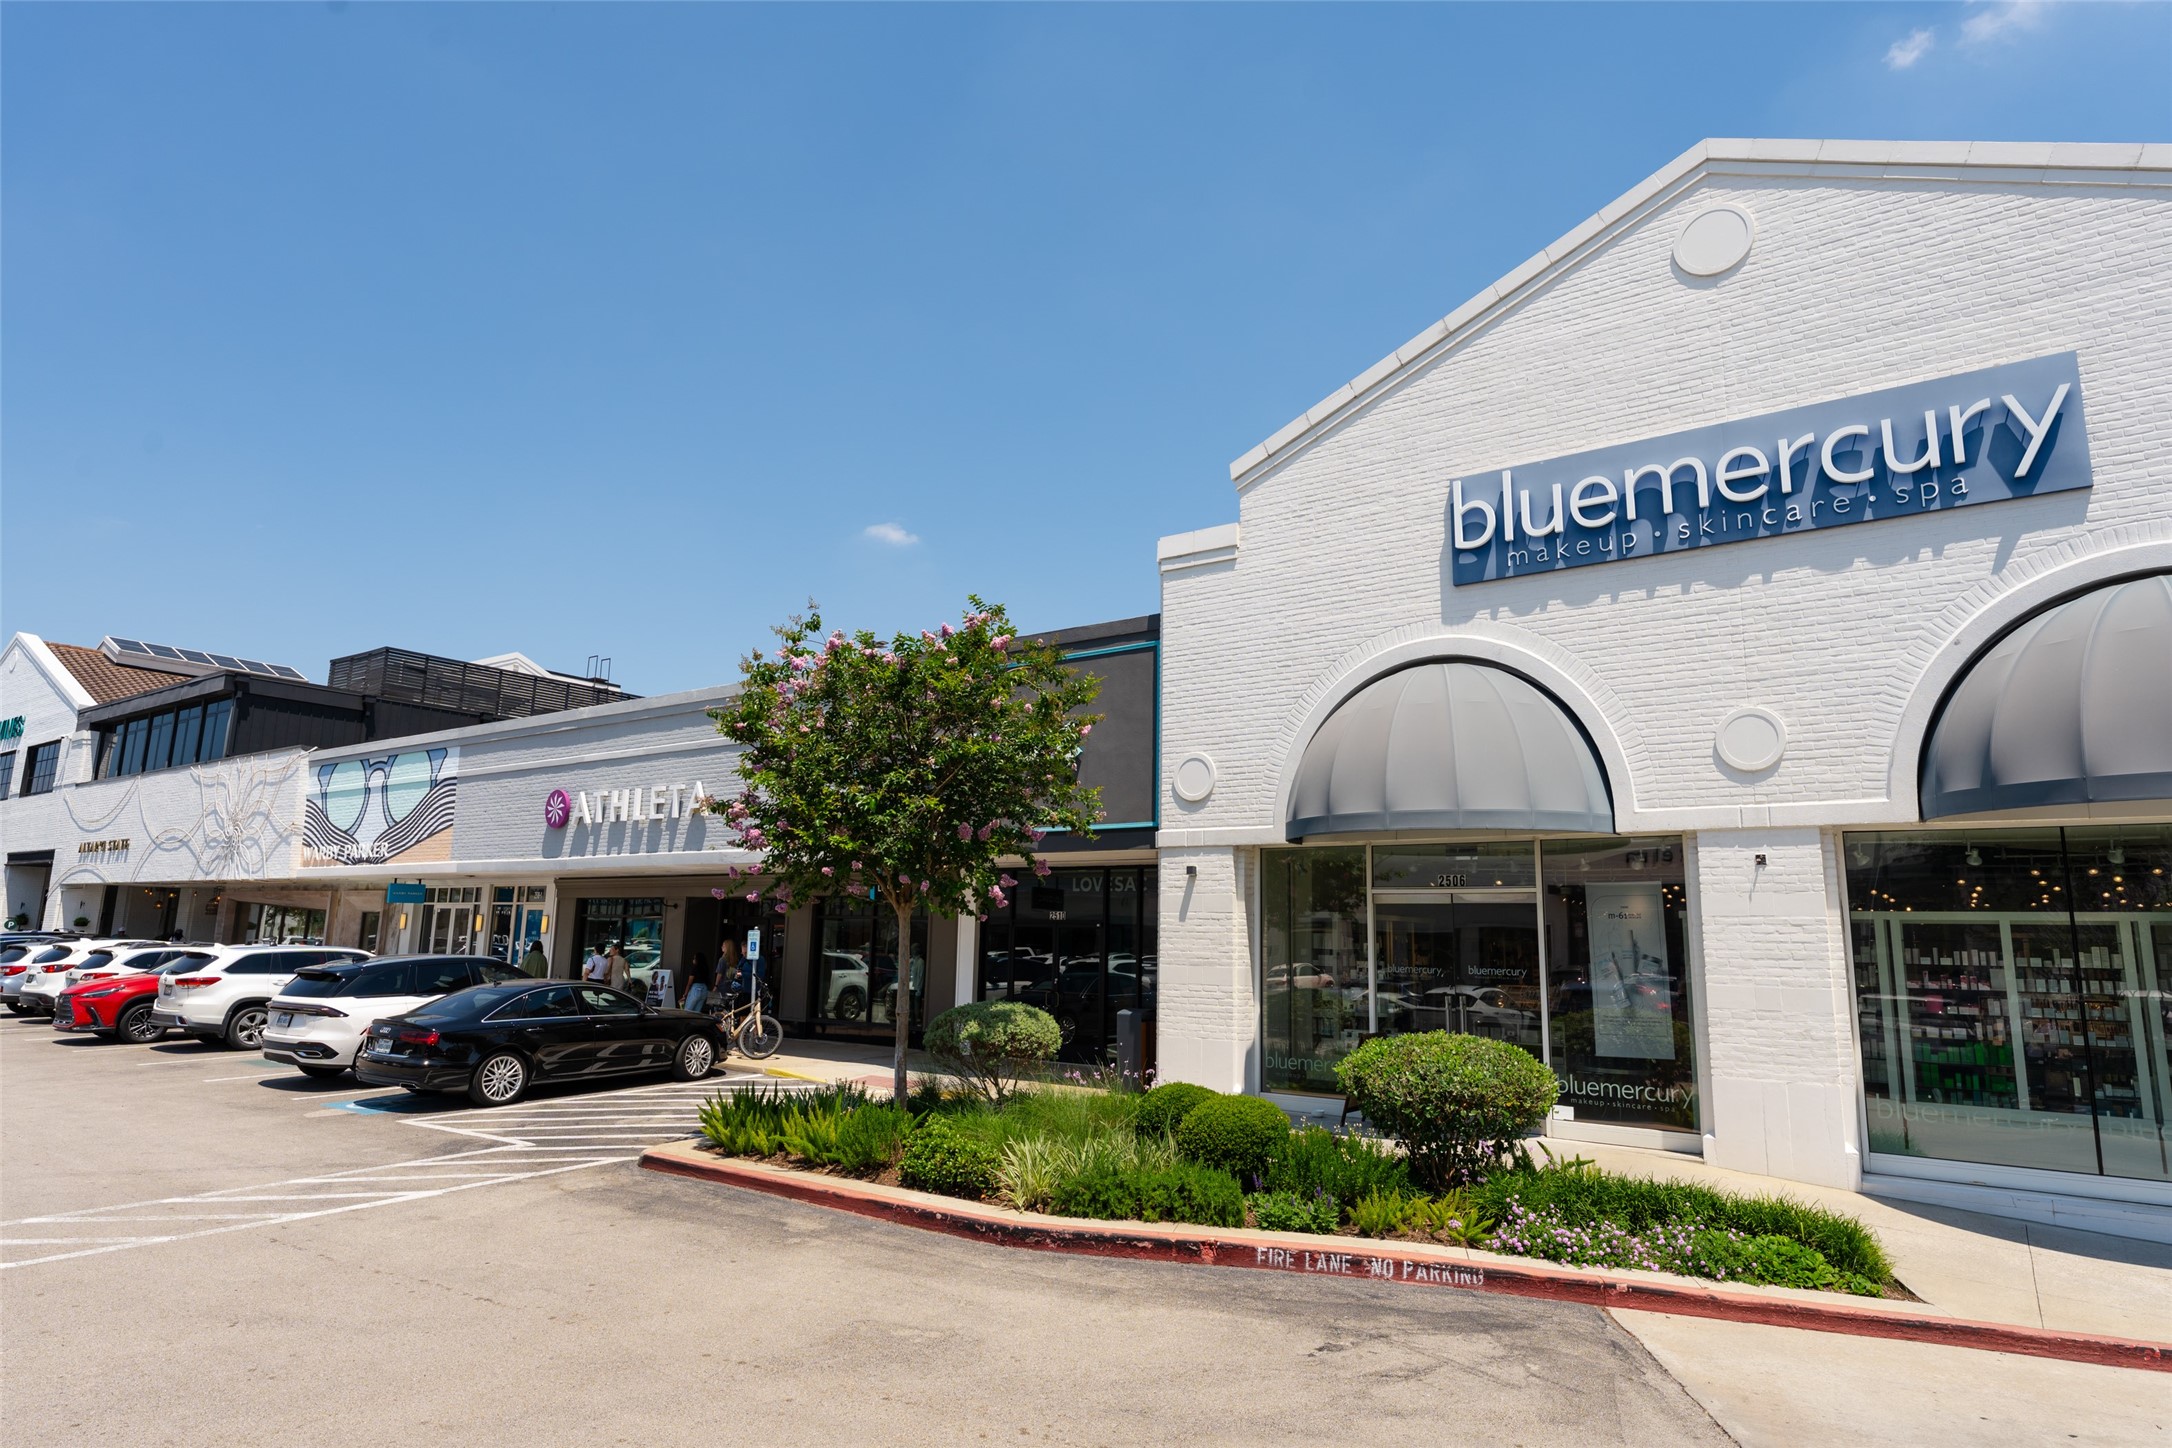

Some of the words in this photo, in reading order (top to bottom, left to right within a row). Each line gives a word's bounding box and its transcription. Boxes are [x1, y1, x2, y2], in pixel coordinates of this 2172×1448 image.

[1452, 381, 2072, 551] bluemercury
[1506, 527, 1637, 567] makeup
[1678, 492, 1852, 540] skincare
[1895, 476, 1970, 511] spa
[572, 780, 709, 825] ATHLETA
[303, 845, 340, 861] WARBY
[344, 842, 389, 860] PARKER
[1072, 876, 1148, 893] LOVSA
[1438, 874, 1466, 887] 2506
[1607, 911, 1628, 920] m-61
[1387, 963, 1442, 977] bluemercury
[1467, 964, 1528, 979] bluemercury
[1557, 1073, 1694, 1110] bluemercury
[1570, 1097, 1605, 1107] makeup
[1612, 1101, 1652, 1111] skincare
[1660, 1105, 1676, 1113] spa
[1257, 1247, 1296, 1268] FIRE
[1305, 1252, 1351, 1273] LANE
[1371, 1258, 1394, 1278] NO
[1403, 1261, 1484, 1286] PARKING
